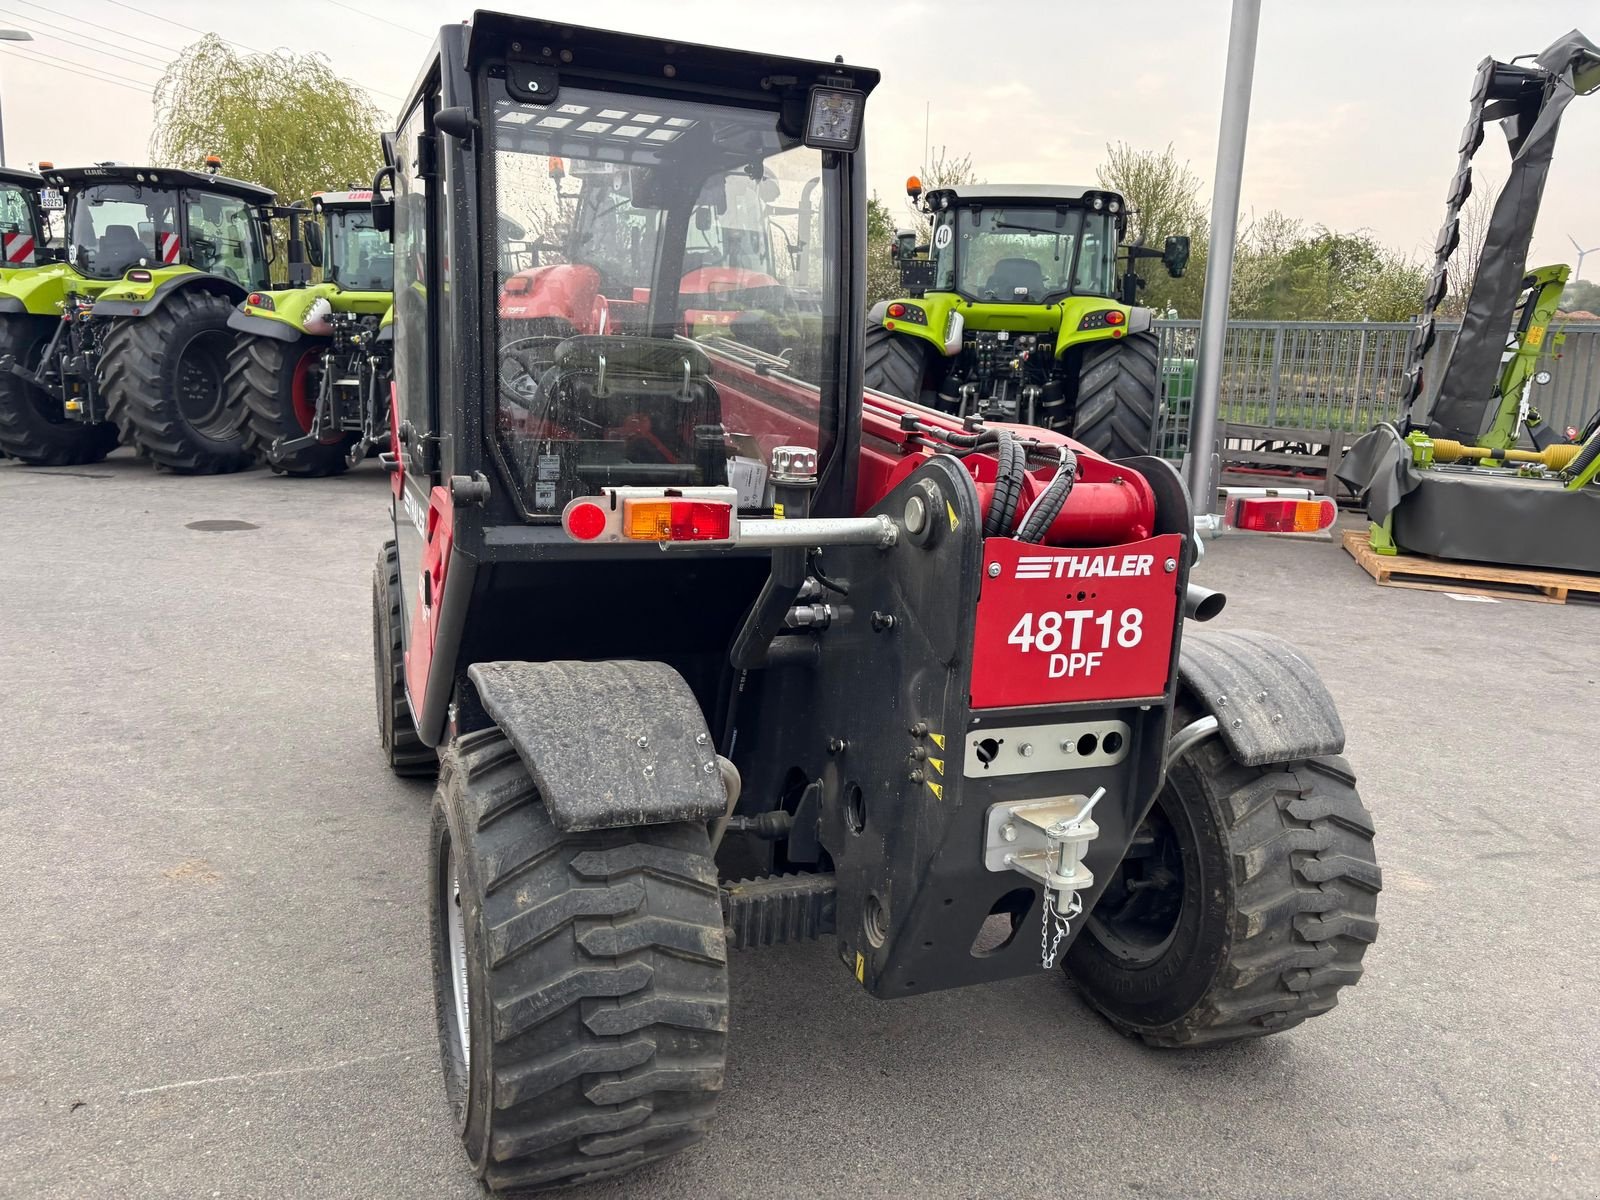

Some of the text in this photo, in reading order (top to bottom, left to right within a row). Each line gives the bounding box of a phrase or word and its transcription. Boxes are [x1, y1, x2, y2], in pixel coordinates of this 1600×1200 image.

[937, 228, 949, 245] 40
[1050, 554, 1154, 578] THALER
[1007, 607, 1144, 653] 48T18
[1048, 652, 1103, 679] DPF
